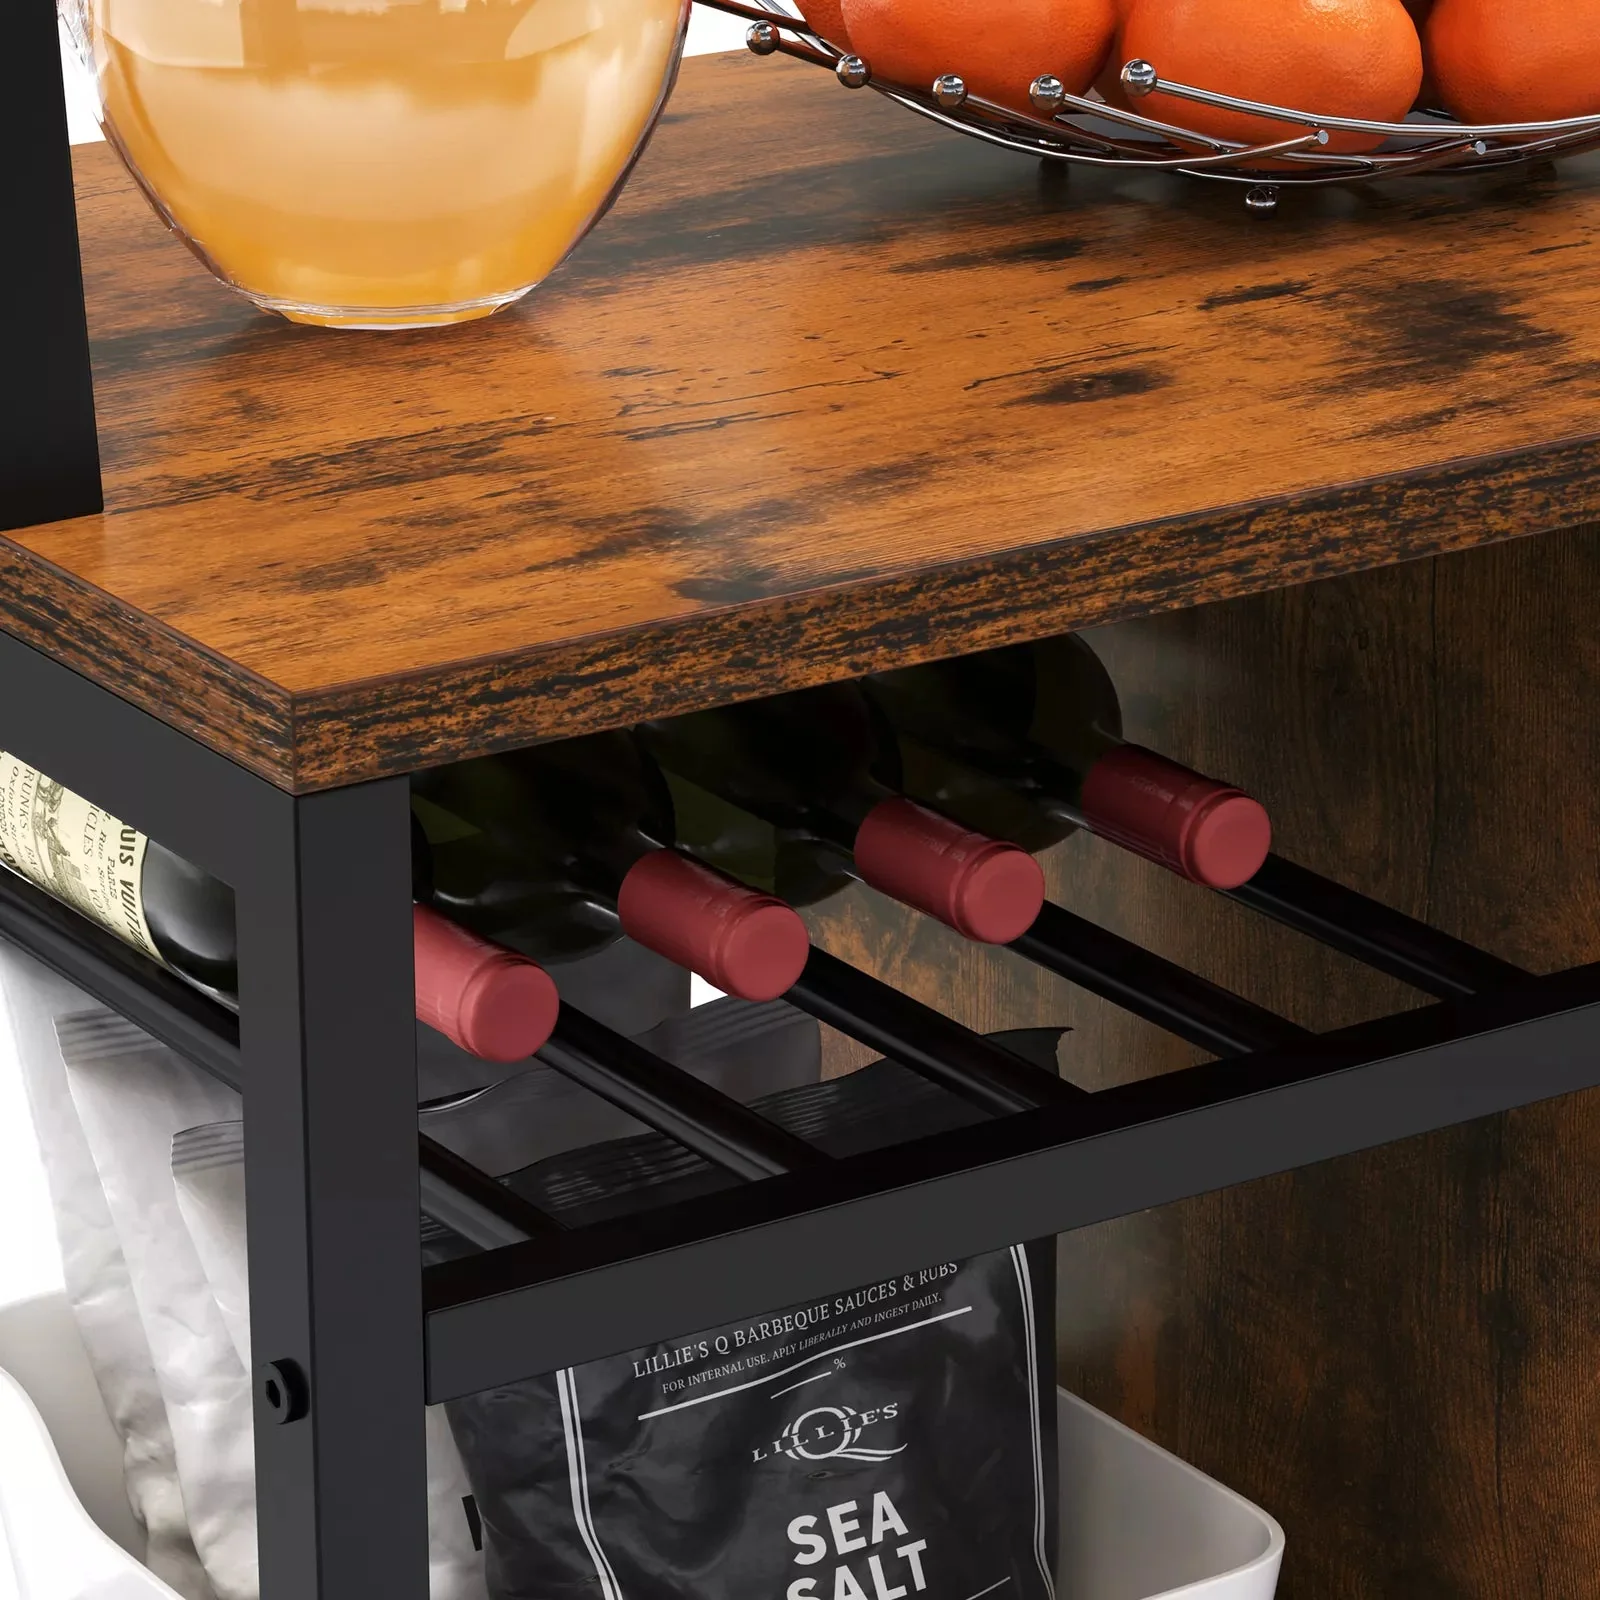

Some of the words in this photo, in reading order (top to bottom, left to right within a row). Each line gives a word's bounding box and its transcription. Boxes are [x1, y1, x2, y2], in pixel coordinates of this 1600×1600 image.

[19, 768, 35, 829] RUNKS
[83, 805, 100, 858] ICLES
[119, 823, 137, 867] UIS
[107, 856, 118, 900] PARIS
[633, 1341, 709, 1378] LILLIE'S
[714, 1335, 731, 1355] Q
[733, 1303, 831, 1348] BARBEQUE
[835, 1280, 898, 1316] SAUCES
[903, 1275, 915, 1292] &
[919, 1263, 958, 1286] RUBS
[662, 1380, 686, 1394] FOR
[688, 1360, 745, 1387] INTERNAL
[746, 1354, 770, 1369] USE.
[772, 1343, 797, 1361] APLY
[799, 1323, 849, 1350] LIBERALLY
[849, 1316, 872, 1331] AND
[874, 1303, 910, 1323] INGEST
[911, 1292, 942, 1311] DAILY.
[752, 1402, 898, 1463] LILLIE'S
[786, 1490, 909, 1566] SEA
